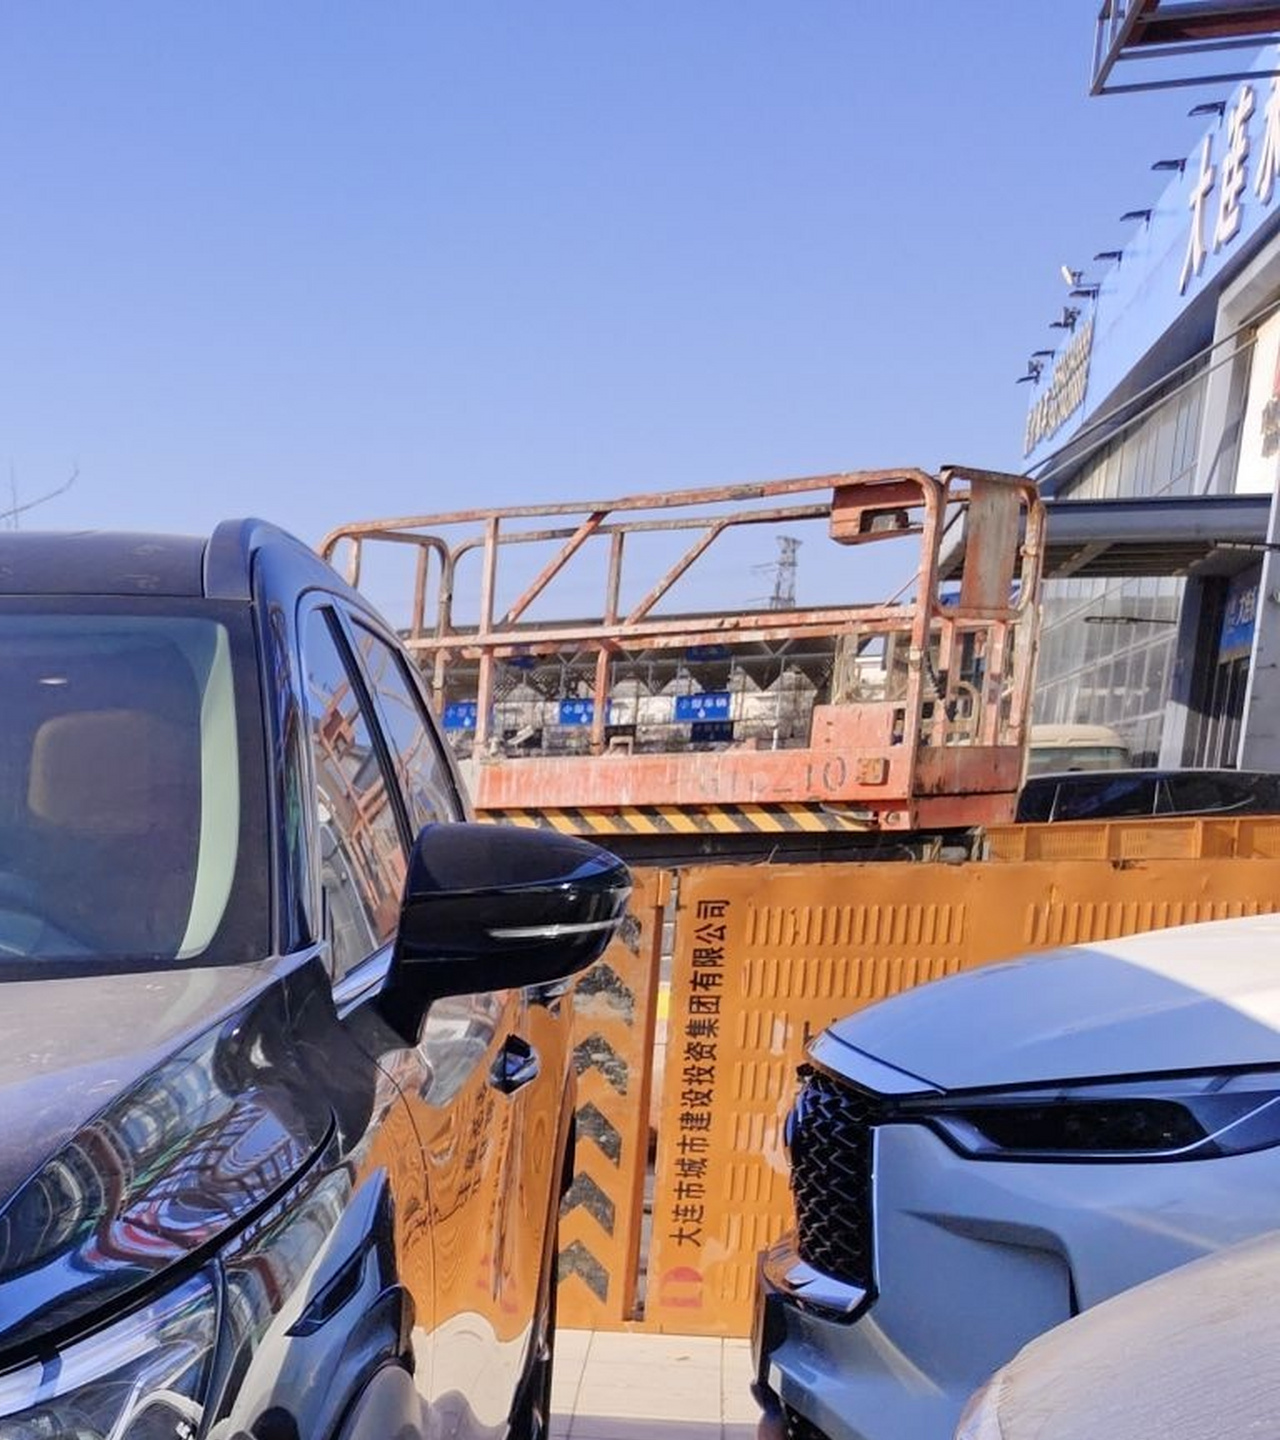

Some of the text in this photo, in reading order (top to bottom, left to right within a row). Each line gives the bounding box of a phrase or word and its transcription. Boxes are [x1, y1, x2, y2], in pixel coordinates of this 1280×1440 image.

[669, 899, 730, 1247] 大连市城市建设投资集团有限公司
